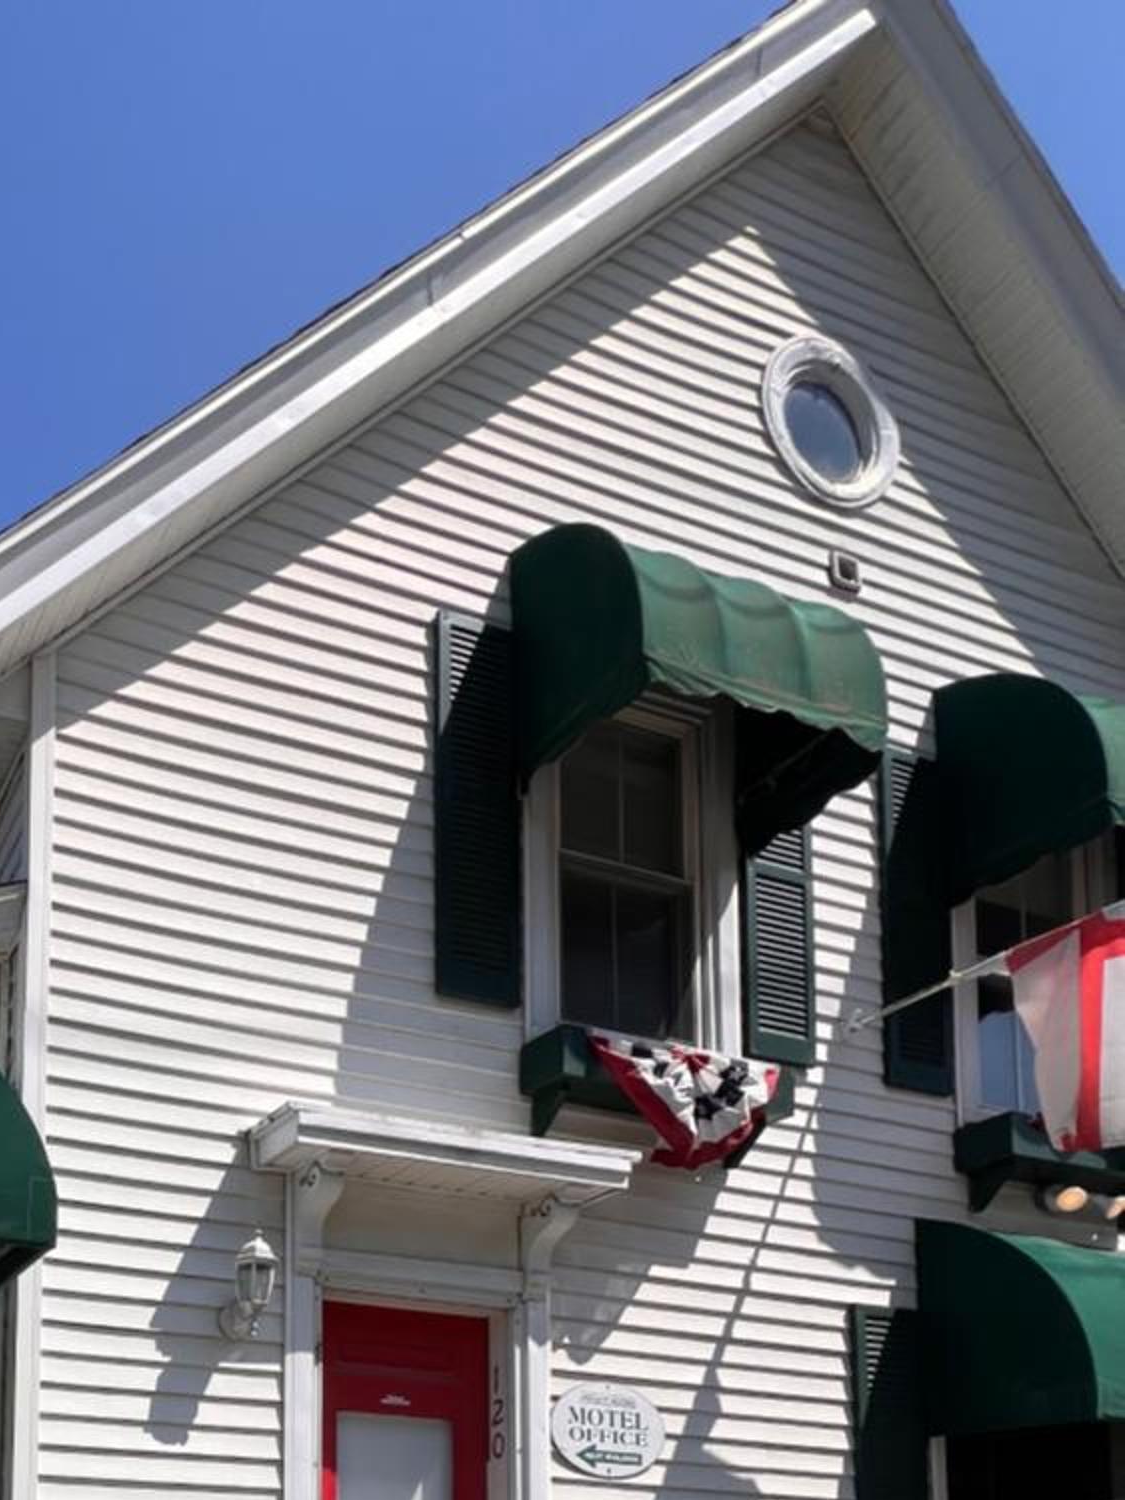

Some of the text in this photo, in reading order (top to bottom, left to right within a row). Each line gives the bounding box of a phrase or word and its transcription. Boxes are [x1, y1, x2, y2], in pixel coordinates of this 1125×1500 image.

[491, 1365, 506, 1459] 120
[568, 1405, 649, 1431] MOTEL
[568, 1426, 648, 1448] OFFICE
